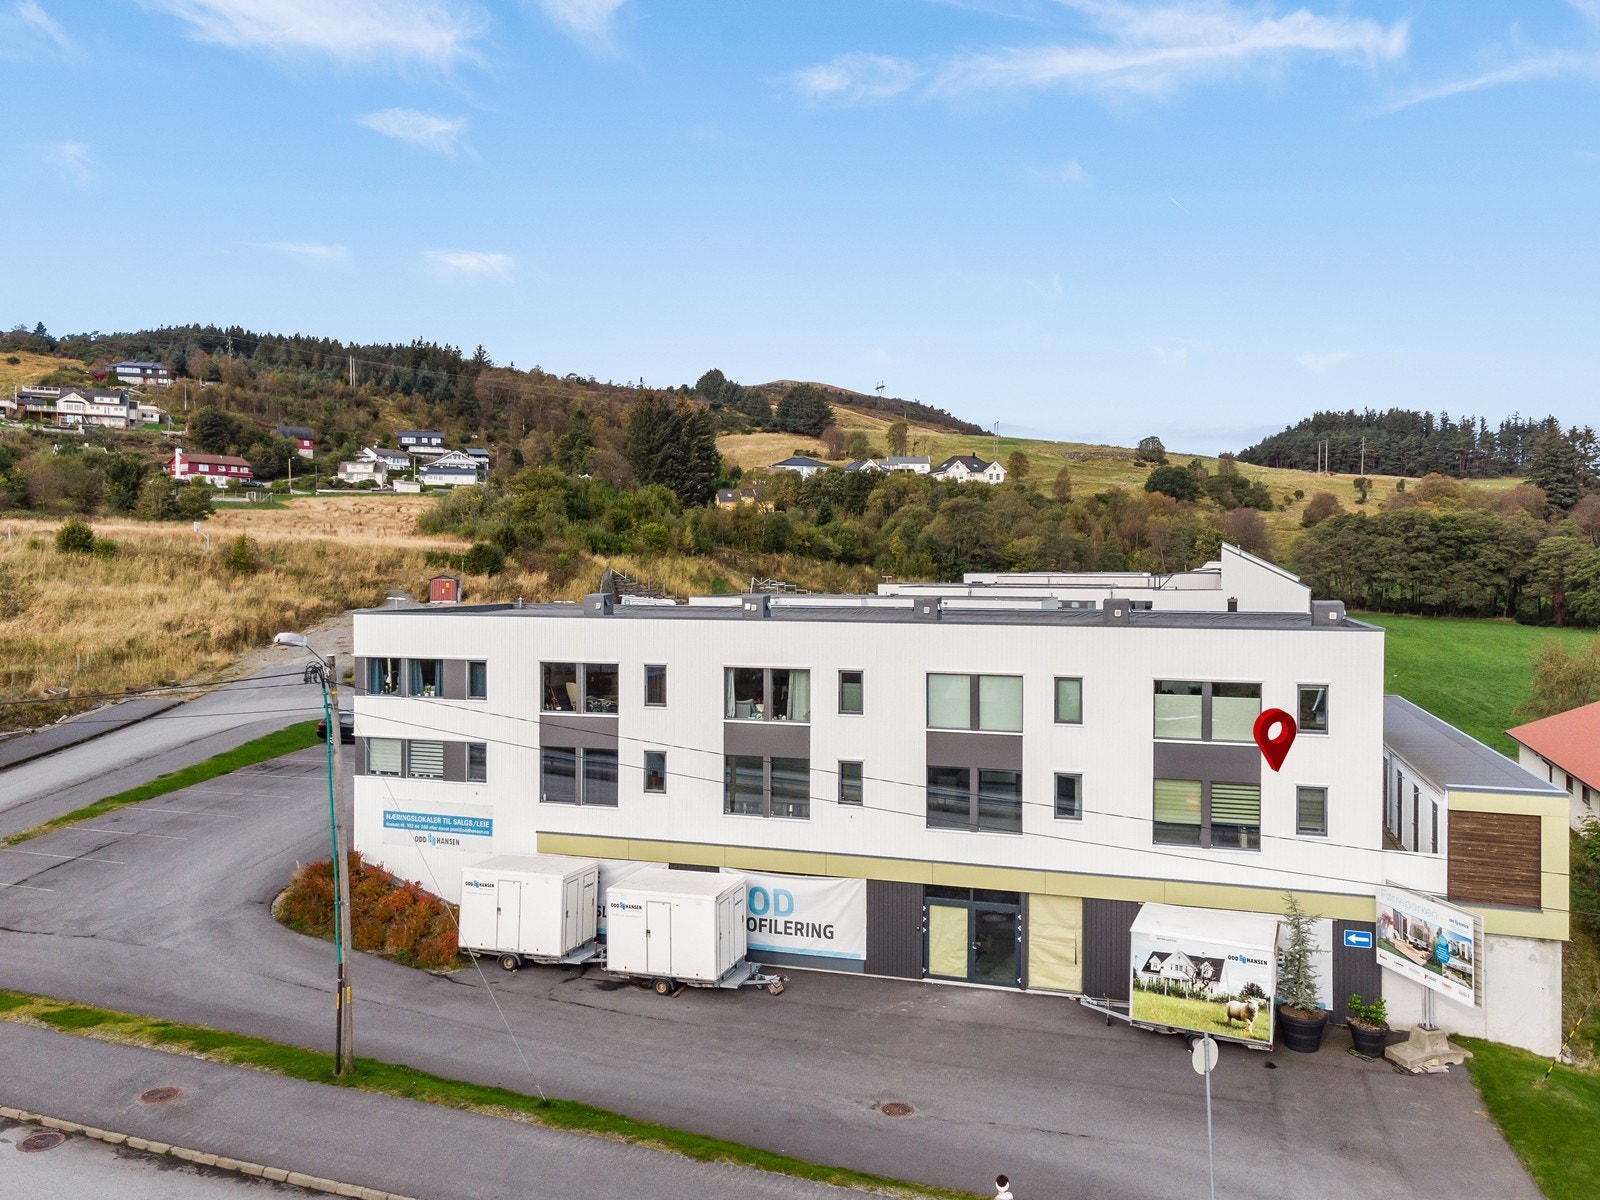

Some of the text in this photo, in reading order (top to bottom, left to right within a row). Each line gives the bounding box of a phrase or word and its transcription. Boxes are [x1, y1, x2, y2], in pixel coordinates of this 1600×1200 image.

[386, 813, 490, 828] NÆRINGSLOKALER TIL SALGS/LEIE
[414, 835, 460, 846] ODD HANSEN
[1246, 957, 1268, 966] HANSEN
